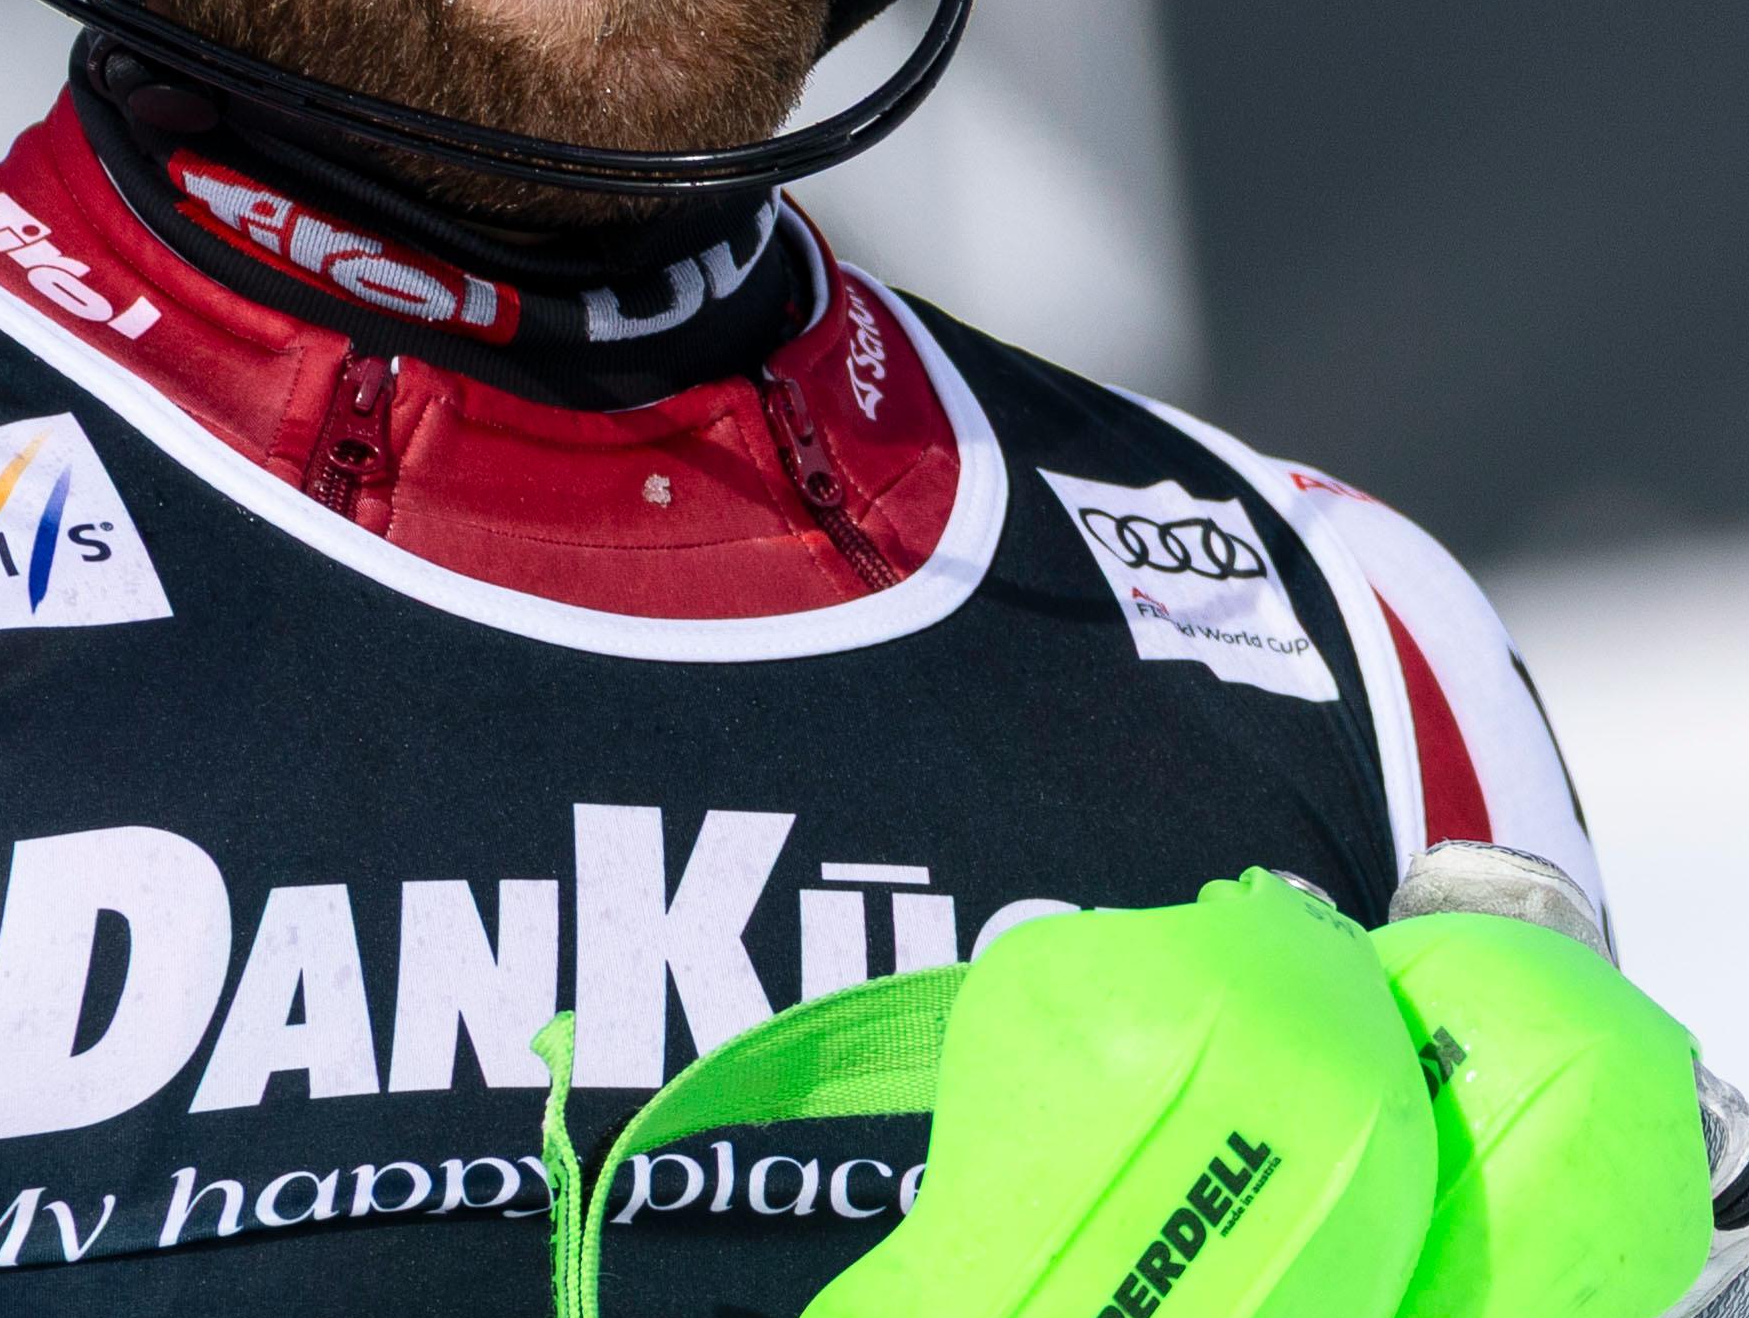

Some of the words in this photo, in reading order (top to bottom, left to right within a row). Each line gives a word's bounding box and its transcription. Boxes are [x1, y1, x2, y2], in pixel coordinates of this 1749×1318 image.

[1198, 625, 1263, 649] World
[1267, 637, 1310, 656] Cup
[1220, 1206, 1246, 1238] made
[1240, 1194, 1255, 1207] in
[1252, 1157, 1282, 1195] austria
